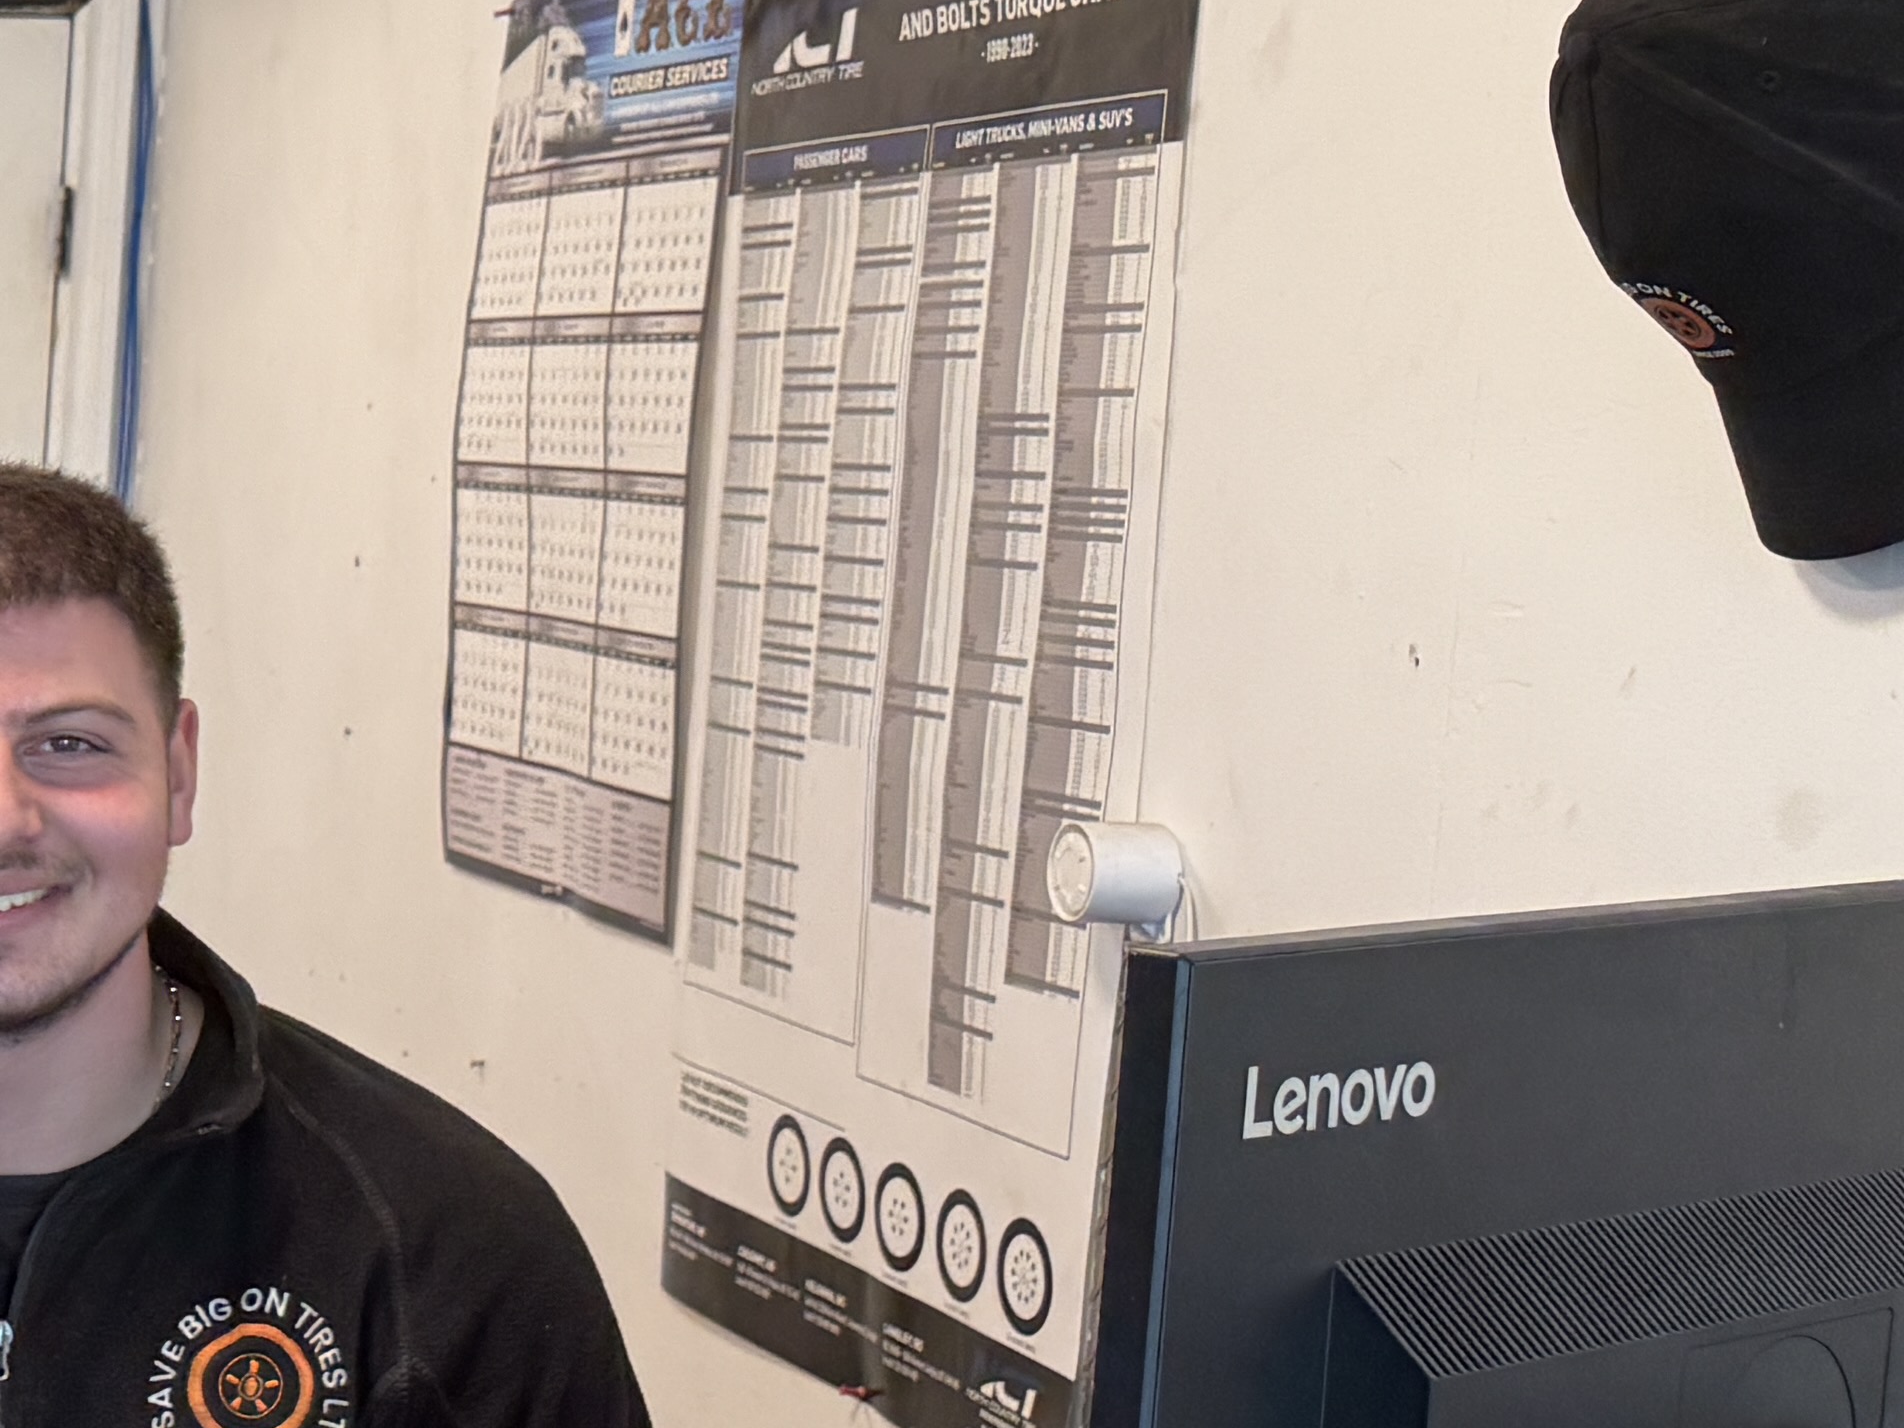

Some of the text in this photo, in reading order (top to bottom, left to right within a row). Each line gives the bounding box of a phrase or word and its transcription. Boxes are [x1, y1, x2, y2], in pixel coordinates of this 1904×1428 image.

[899, 9, 933, 41] AND
[610, 58, 728, 97] COURIER SERVICES
[955, 130, 984, 149] LIGHT
[1028, 113, 1085, 139] MINI-VANS
[1098, 107, 1134, 129] SUV'S
[794, 145, 868, 171] PASSENGER CARS
[1637, 282, 1733, 335] ON TIRES
[1242, 1060, 1436, 1140] Lenovo
[178, 1297, 232, 1340] BIG
[241, 1287, 290, 1317] ON
[294, 1302, 347, 1389] TIRES
